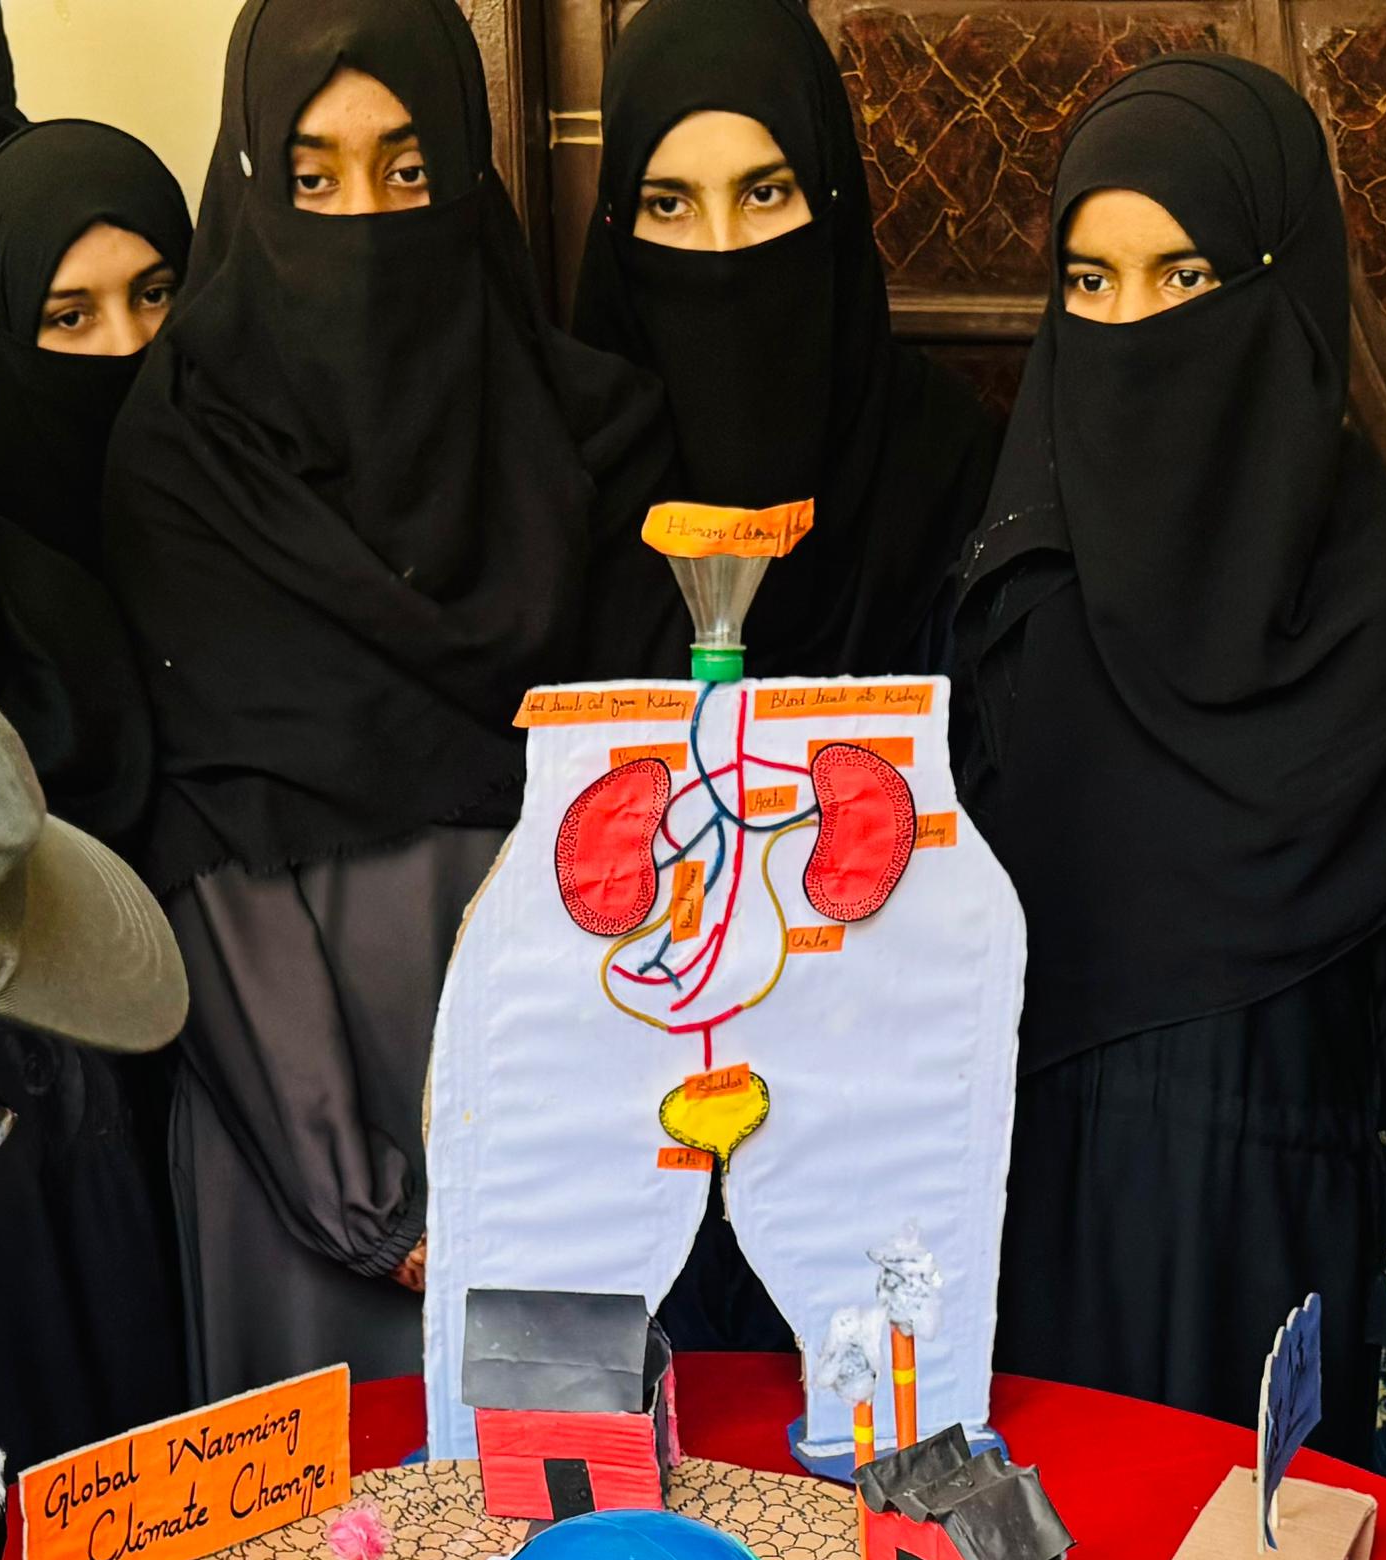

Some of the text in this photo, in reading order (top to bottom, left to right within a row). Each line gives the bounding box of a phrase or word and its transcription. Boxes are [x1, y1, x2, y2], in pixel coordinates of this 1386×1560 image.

[665, 515, 727, 540] Human
[771, 692, 805, 709] Blood
[916, 815, 946, 845] idney
[44, 1408, 301, 1529] Global Warming
